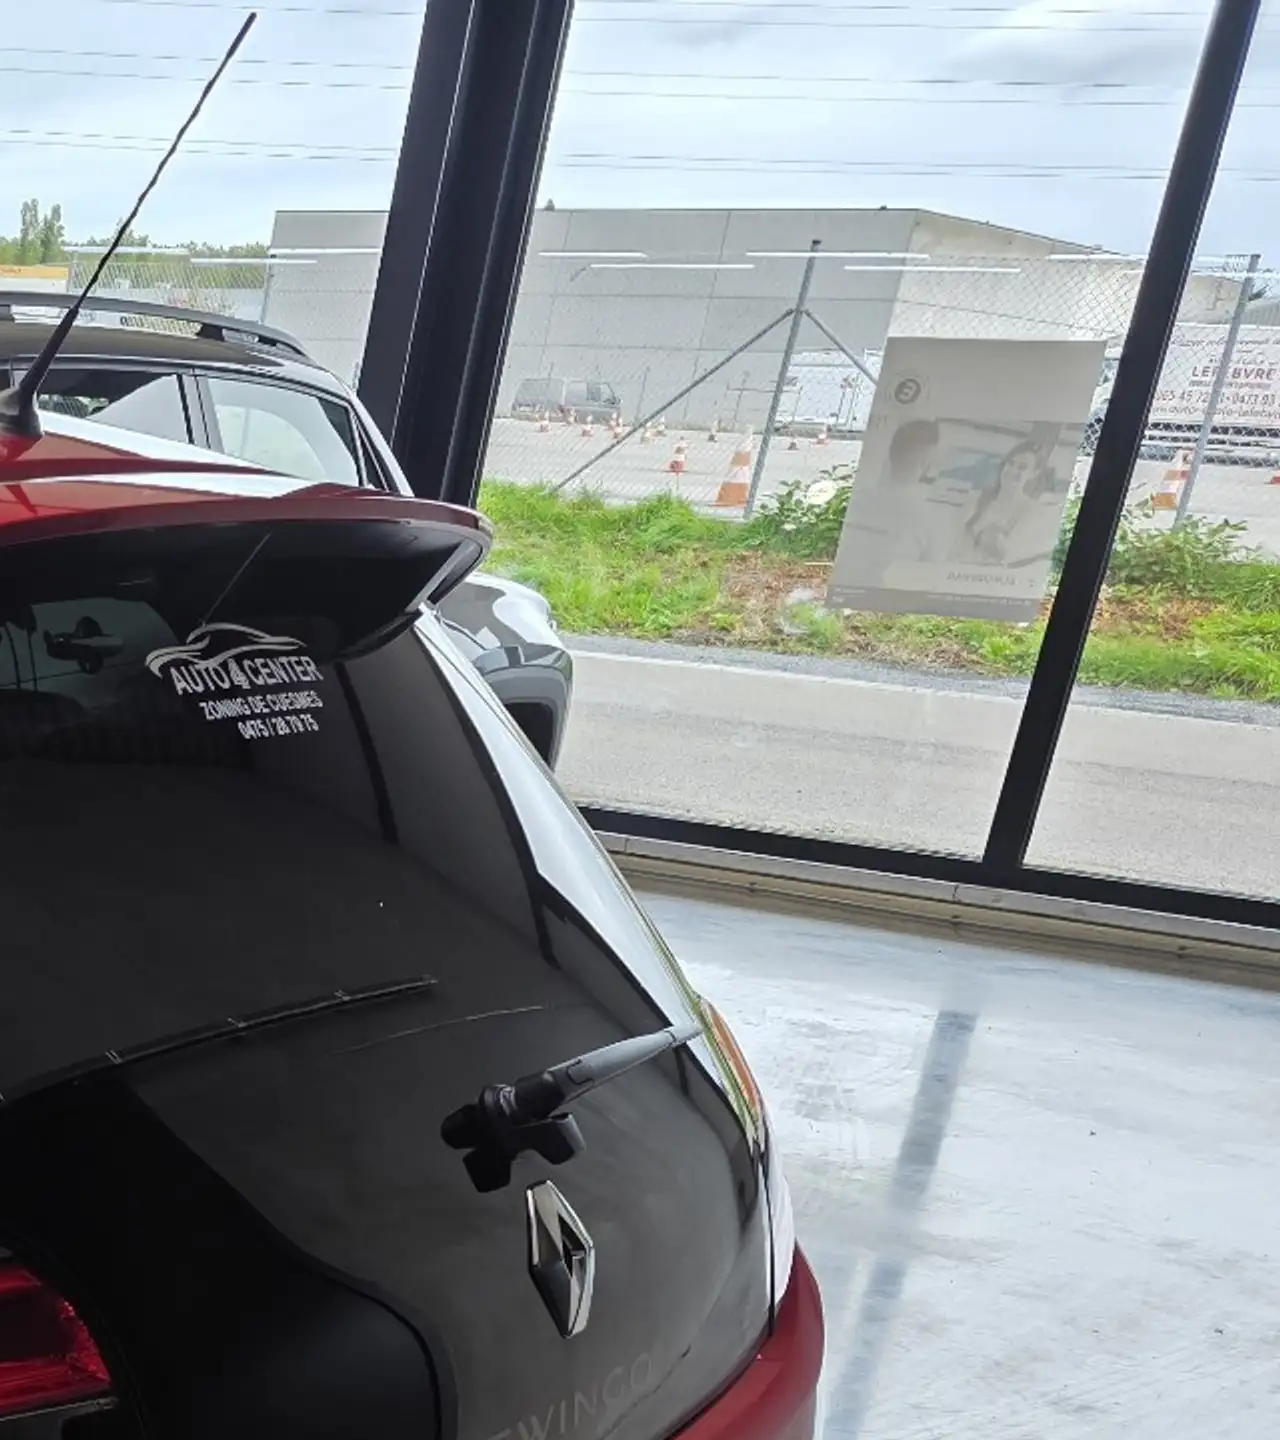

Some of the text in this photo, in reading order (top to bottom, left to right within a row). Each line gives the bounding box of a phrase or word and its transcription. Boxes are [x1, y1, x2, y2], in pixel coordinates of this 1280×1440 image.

[1192, 366, 1277, 380] LEFBVRE
[199, 690, 323, 720] ZONING DE CUESMES
